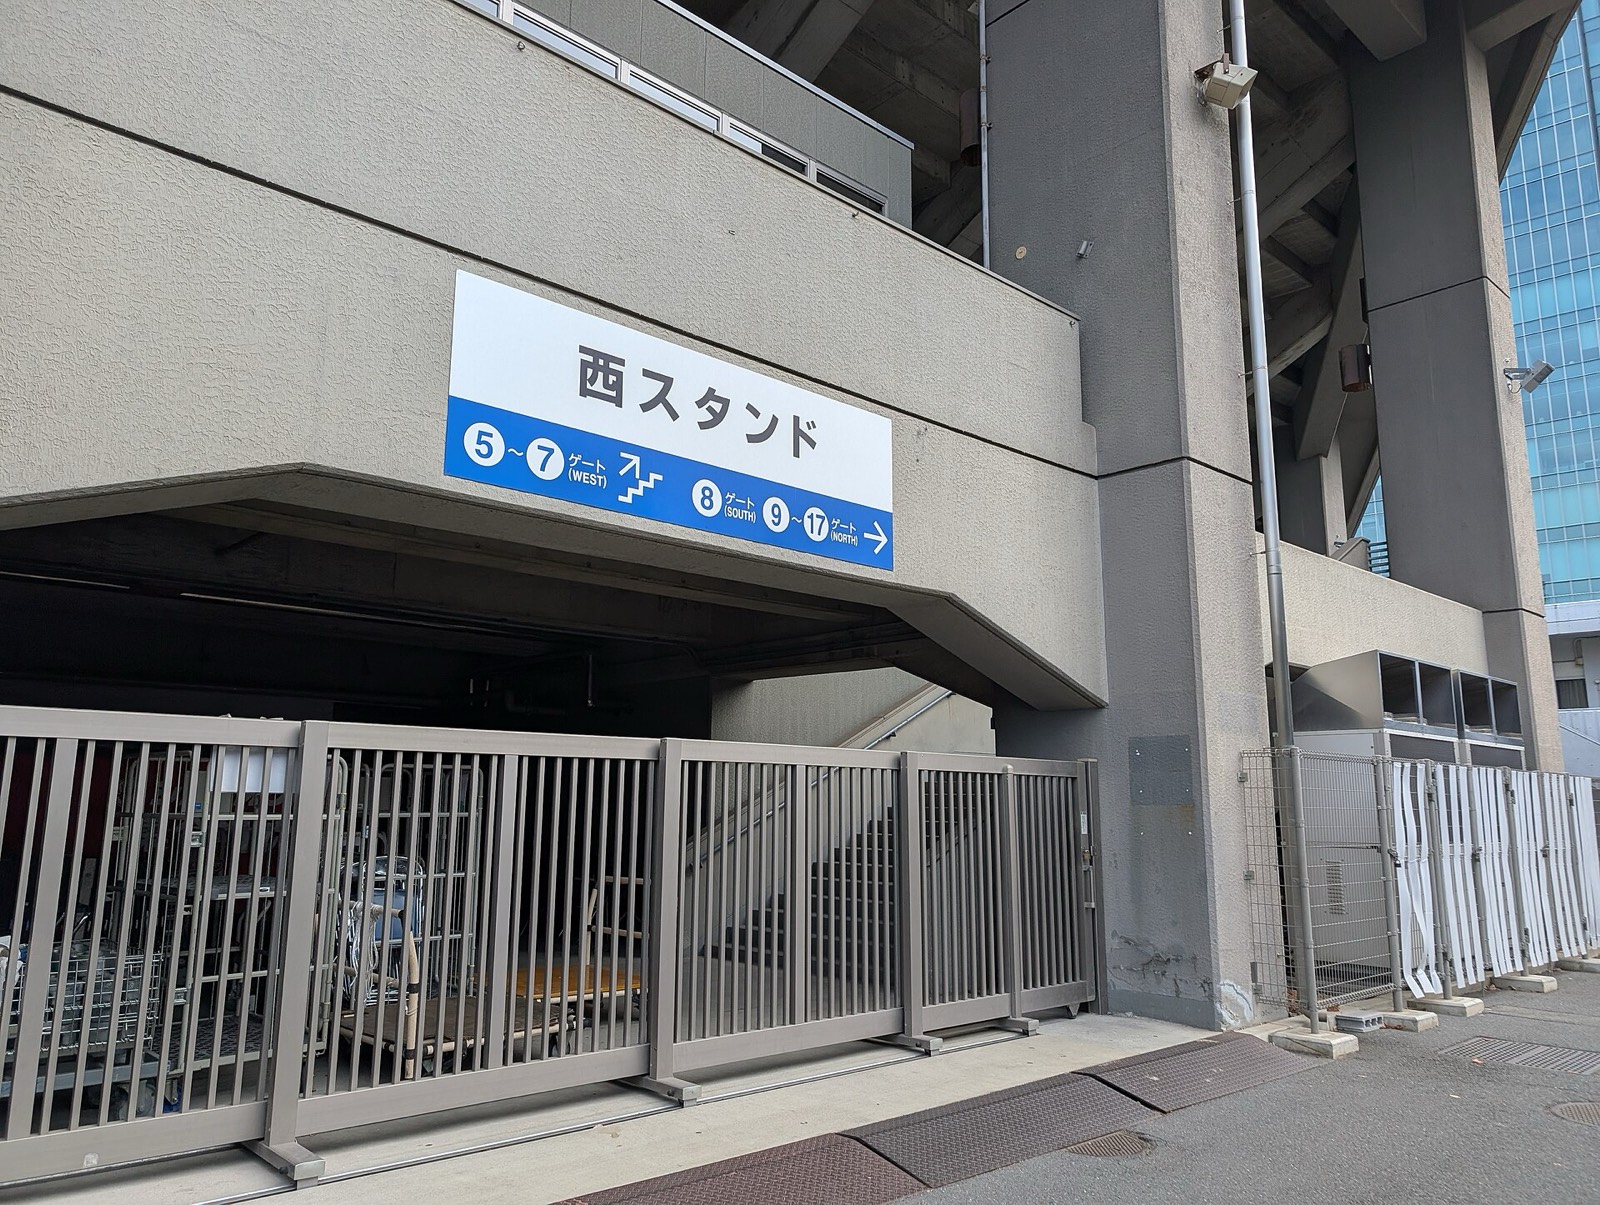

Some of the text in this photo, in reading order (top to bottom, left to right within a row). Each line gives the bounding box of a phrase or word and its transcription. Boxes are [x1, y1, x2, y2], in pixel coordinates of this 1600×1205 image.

[579, 345, 817, 459] 西スタンド
[568, 452, 606, 474] ゲート
[567, 467, 608, 489] (WEST)
[700, 486, 714, 511] 8
[724, 491, 755, 510] ゲート
[723, 505, 757, 524] (SOUTH)
[807, 512, 826, 536] 17
[831, 517, 857, 534] ゲート
[830, 530, 858, 547] (NORTH)
